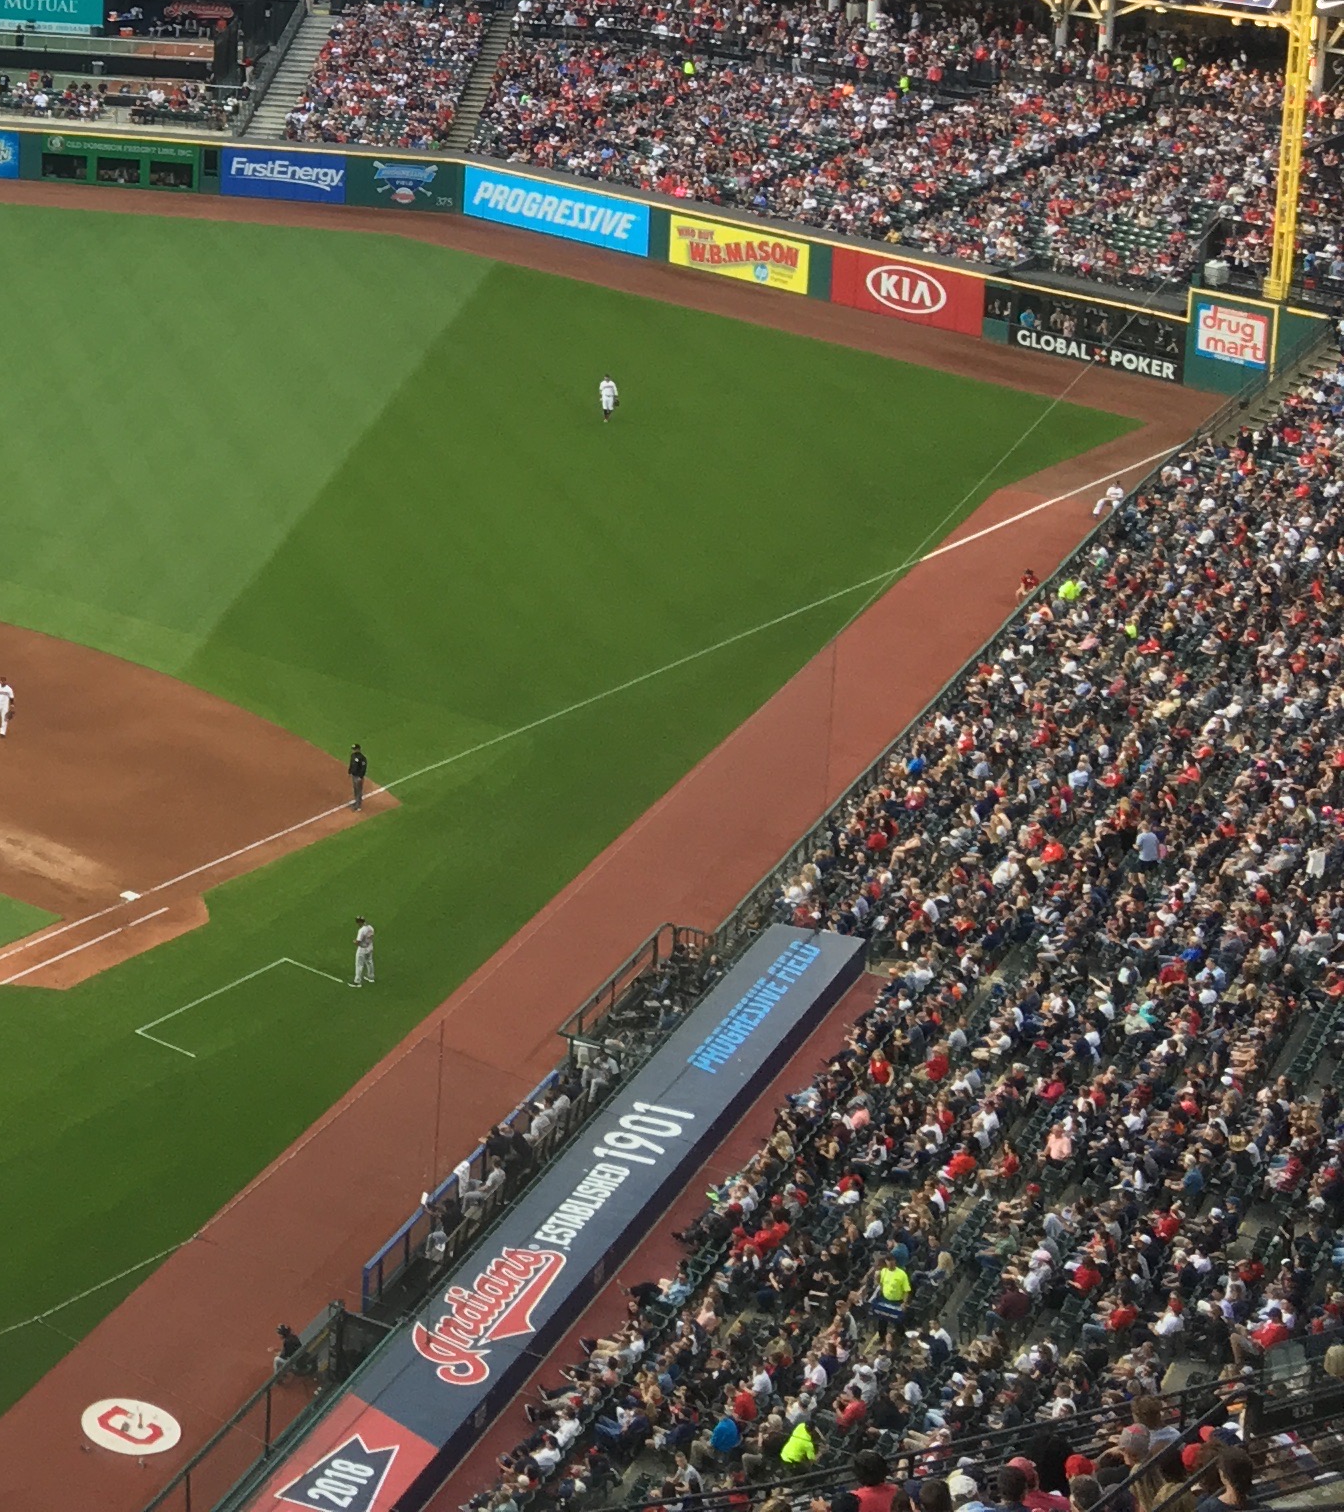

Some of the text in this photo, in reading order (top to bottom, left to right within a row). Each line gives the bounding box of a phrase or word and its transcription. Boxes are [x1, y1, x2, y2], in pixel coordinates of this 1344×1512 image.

[229, 155, 344, 190] FirstEnergy
[436, 196, 453, 206] 375
[473, 180, 637, 240] PROGRESSIVE
[689, 240, 800, 269] W.B.MASON
[879, 275, 933, 307] KIA
[1202, 312, 1256, 344] drug
[1016, 329, 1175, 380] GLOBAL POKER
[1205, 334, 1266, 363] mart
[533, 1100, 696, 1248] ESTABLISHED 1901
[412, 1245, 568, 1387] Indians
[307, 1457, 377, 1510] 2018
